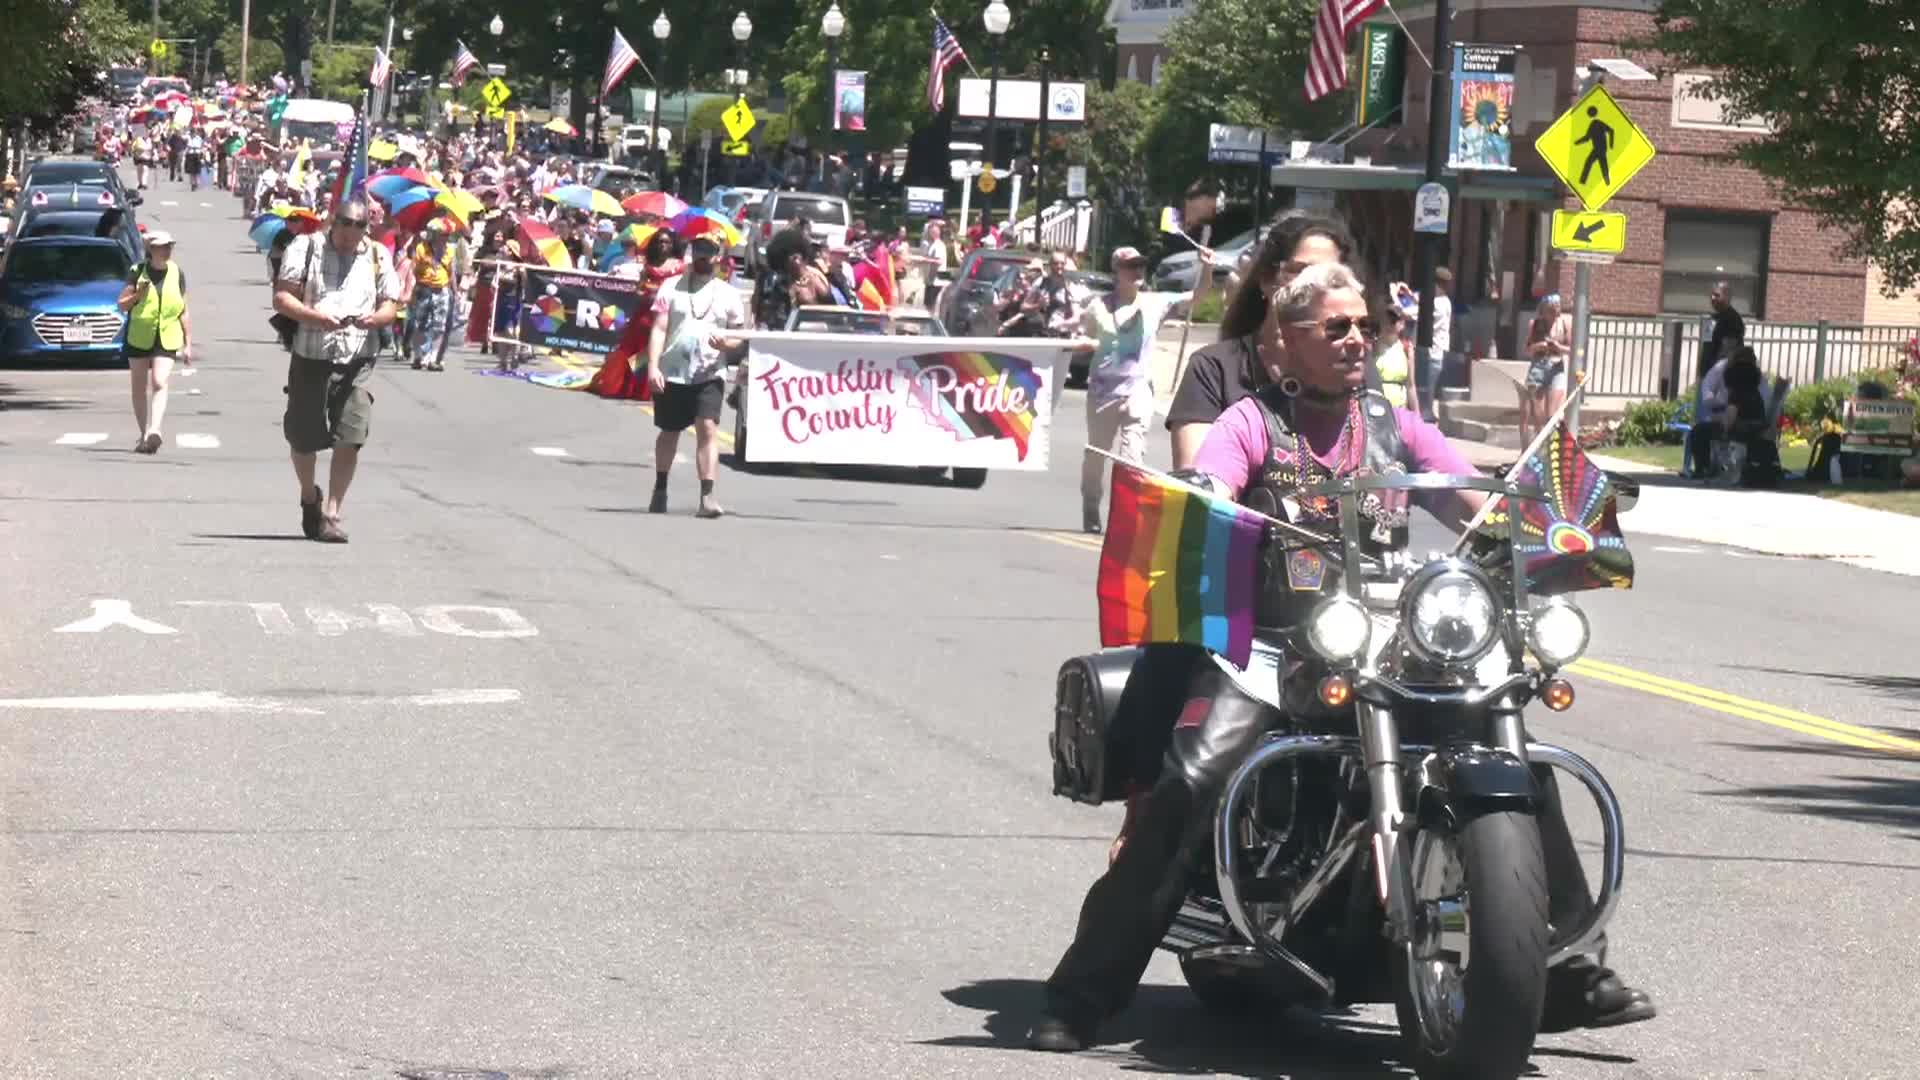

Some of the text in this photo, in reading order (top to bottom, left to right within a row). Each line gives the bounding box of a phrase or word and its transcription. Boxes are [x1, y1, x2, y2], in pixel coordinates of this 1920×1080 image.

[1463, 62, 1497, 71] District
[755, 359, 896, 411] Franklin
[916, 363, 1029, 416] Pride
[781, 394, 897, 444] County
